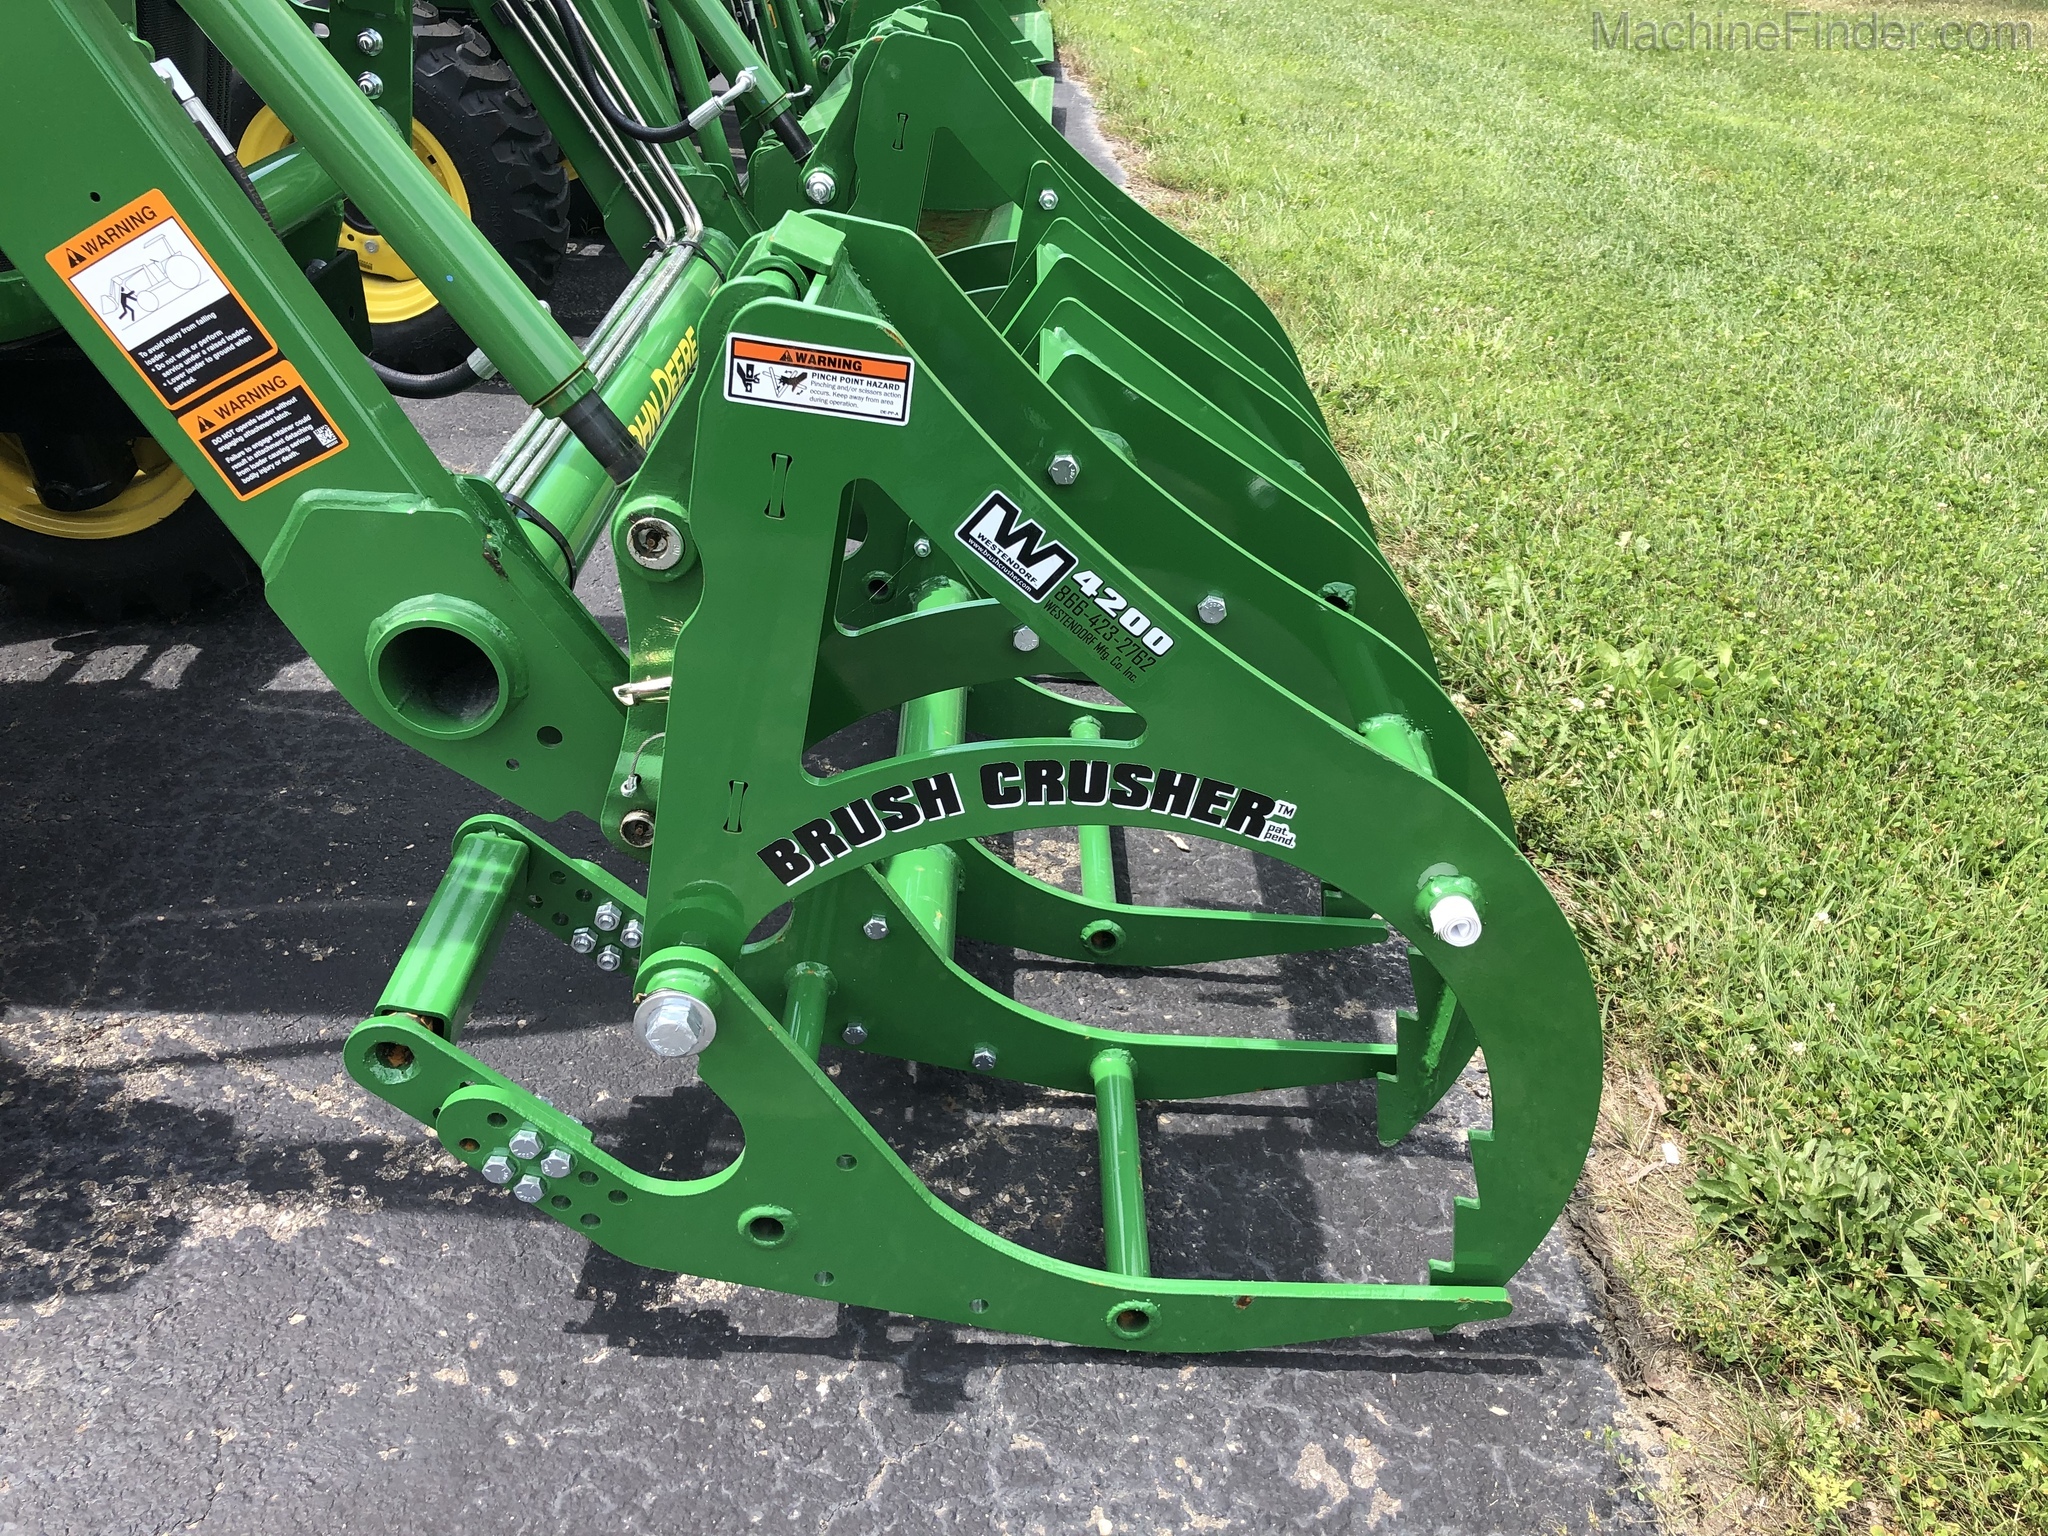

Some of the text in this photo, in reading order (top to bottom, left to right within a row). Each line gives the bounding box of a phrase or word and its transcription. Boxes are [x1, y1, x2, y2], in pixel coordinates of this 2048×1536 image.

[80, 205, 158, 256] WARNING
[138, 312, 217, 359] To avoid injury from falling
[144, 351, 167, 366] loader:
[154, 329, 223, 371] Do not walk or perform
[161, 363, 184, 378] service
[183, 351, 202, 365] under
[206, 338, 227, 352] raised
[225, 327, 248, 342] loader.
[166, 334, 253, 386] Lower loader to ground when
[650, 325, 699, 415] DEERE
[796, 351, 863, 371] WARNING
[811, 372, 900, 391] PINCH POINT HAZARD
[173, 376, 197, 393] parked.
[213, 375, 288, 420] WARNING
[809, 389, 831, 397] occurs.
[832, 391, 848, 400] Keep
[848, 394, 865, 402] away
[865, 395, 880, 403] from
[809, 396, 859, 408] during operation.
[811, 380, 902, 398] Pinching and/or scissors action
[211, 396, 298, 445] DO NOT operate loader without
[217, 409, 292, 452] engaging attachment latch.
[225, 449, 246, 464] Failure
[251, 434, 274, 450] engage
[271, 423, 295, 439] retainer
[294, 414, 312, 427] could
[231, 457, 248, 471] result
[253, 438, 286, 458] attachment
[284, 424, 314, 441] detaching
[235, 467, 252, 477] from
[249, 457, 268, 471] loader
[267, 445, 291, 460] causing
[289, 434, 312, 449] serious
[240, 471, 260, 484] bodily
[258, 462, 276, 476] injury
[281, 450, 300, 463] death.
[968, 538, 1032, 593] www.brushcrusher.com
[977, 532, 1038, 584] WESTENDORF
[1054, 585, 1157, 672] 866-423-2762
[1071, 570, 1175, 657] 4200
[1043, 599, 1138, 683] WESTENDORF Mfg. Co. Inc.
[756, 771, 966, 887] BRUSH
[979, 759, 1277, 839] CRUSHER
[1263, 832, 1294, 847] pend.
[1267, 824, 1288, 837] pat.
